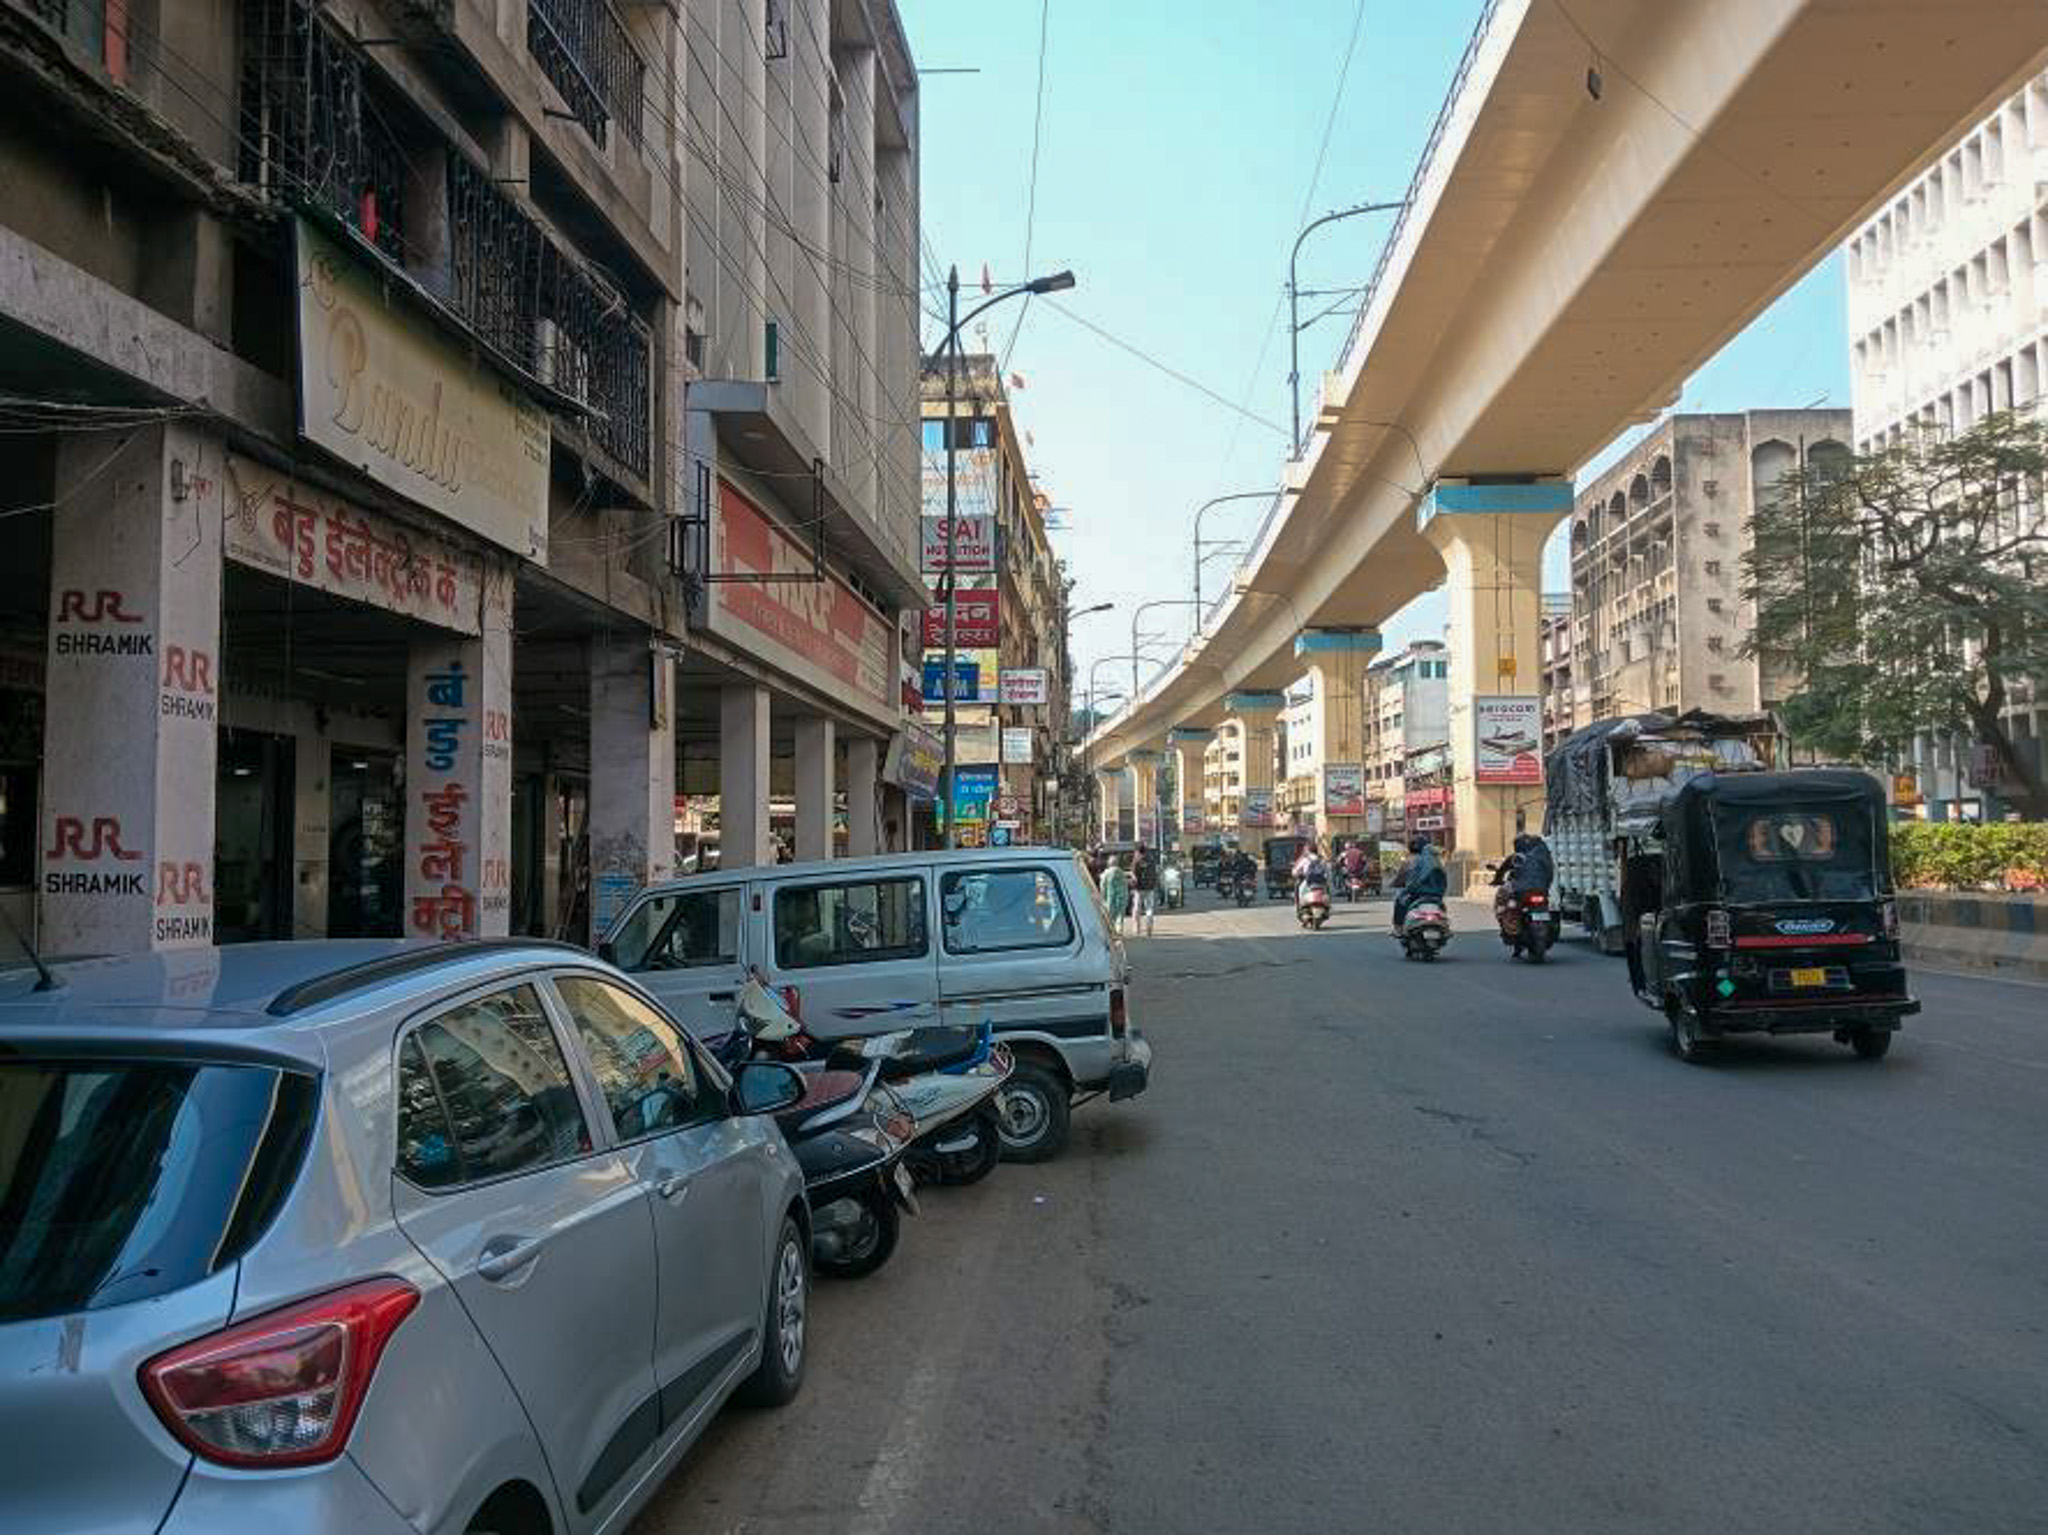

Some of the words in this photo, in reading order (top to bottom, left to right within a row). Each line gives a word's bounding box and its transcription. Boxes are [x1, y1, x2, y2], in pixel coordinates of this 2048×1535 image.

[56, 590, 144, 624] RR
[56, 632, 153, 656] SHRAMIK
[163, 645, 214, 694] RR
[46, 816, 143, 861] RR
[45, 872, 144, 895] SHRAMIK
[157, 862, 210, 905] RR
